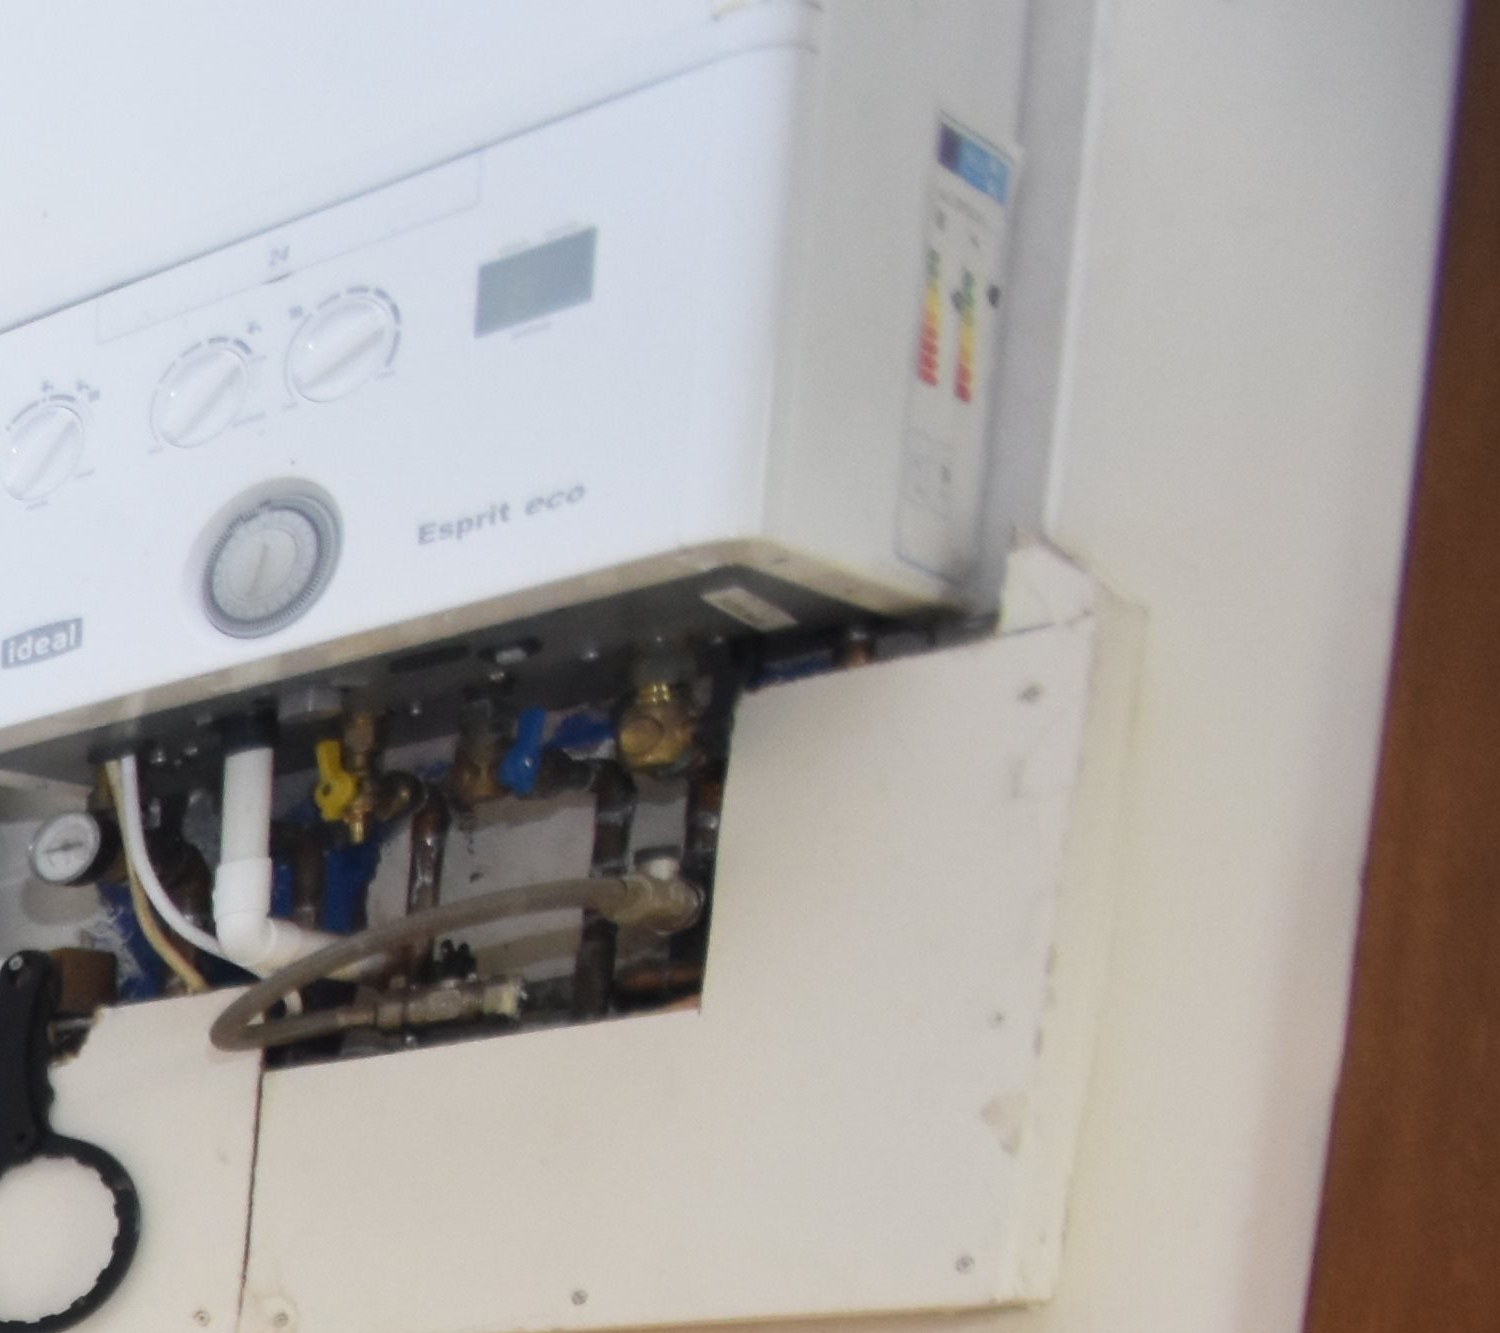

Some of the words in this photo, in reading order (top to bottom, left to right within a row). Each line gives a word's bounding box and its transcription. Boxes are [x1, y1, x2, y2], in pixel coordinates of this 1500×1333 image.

[418, 502, 510, 545] Esprit
[525, 484, 586, 516] eco
[8, 623, 76, 664] ideal
